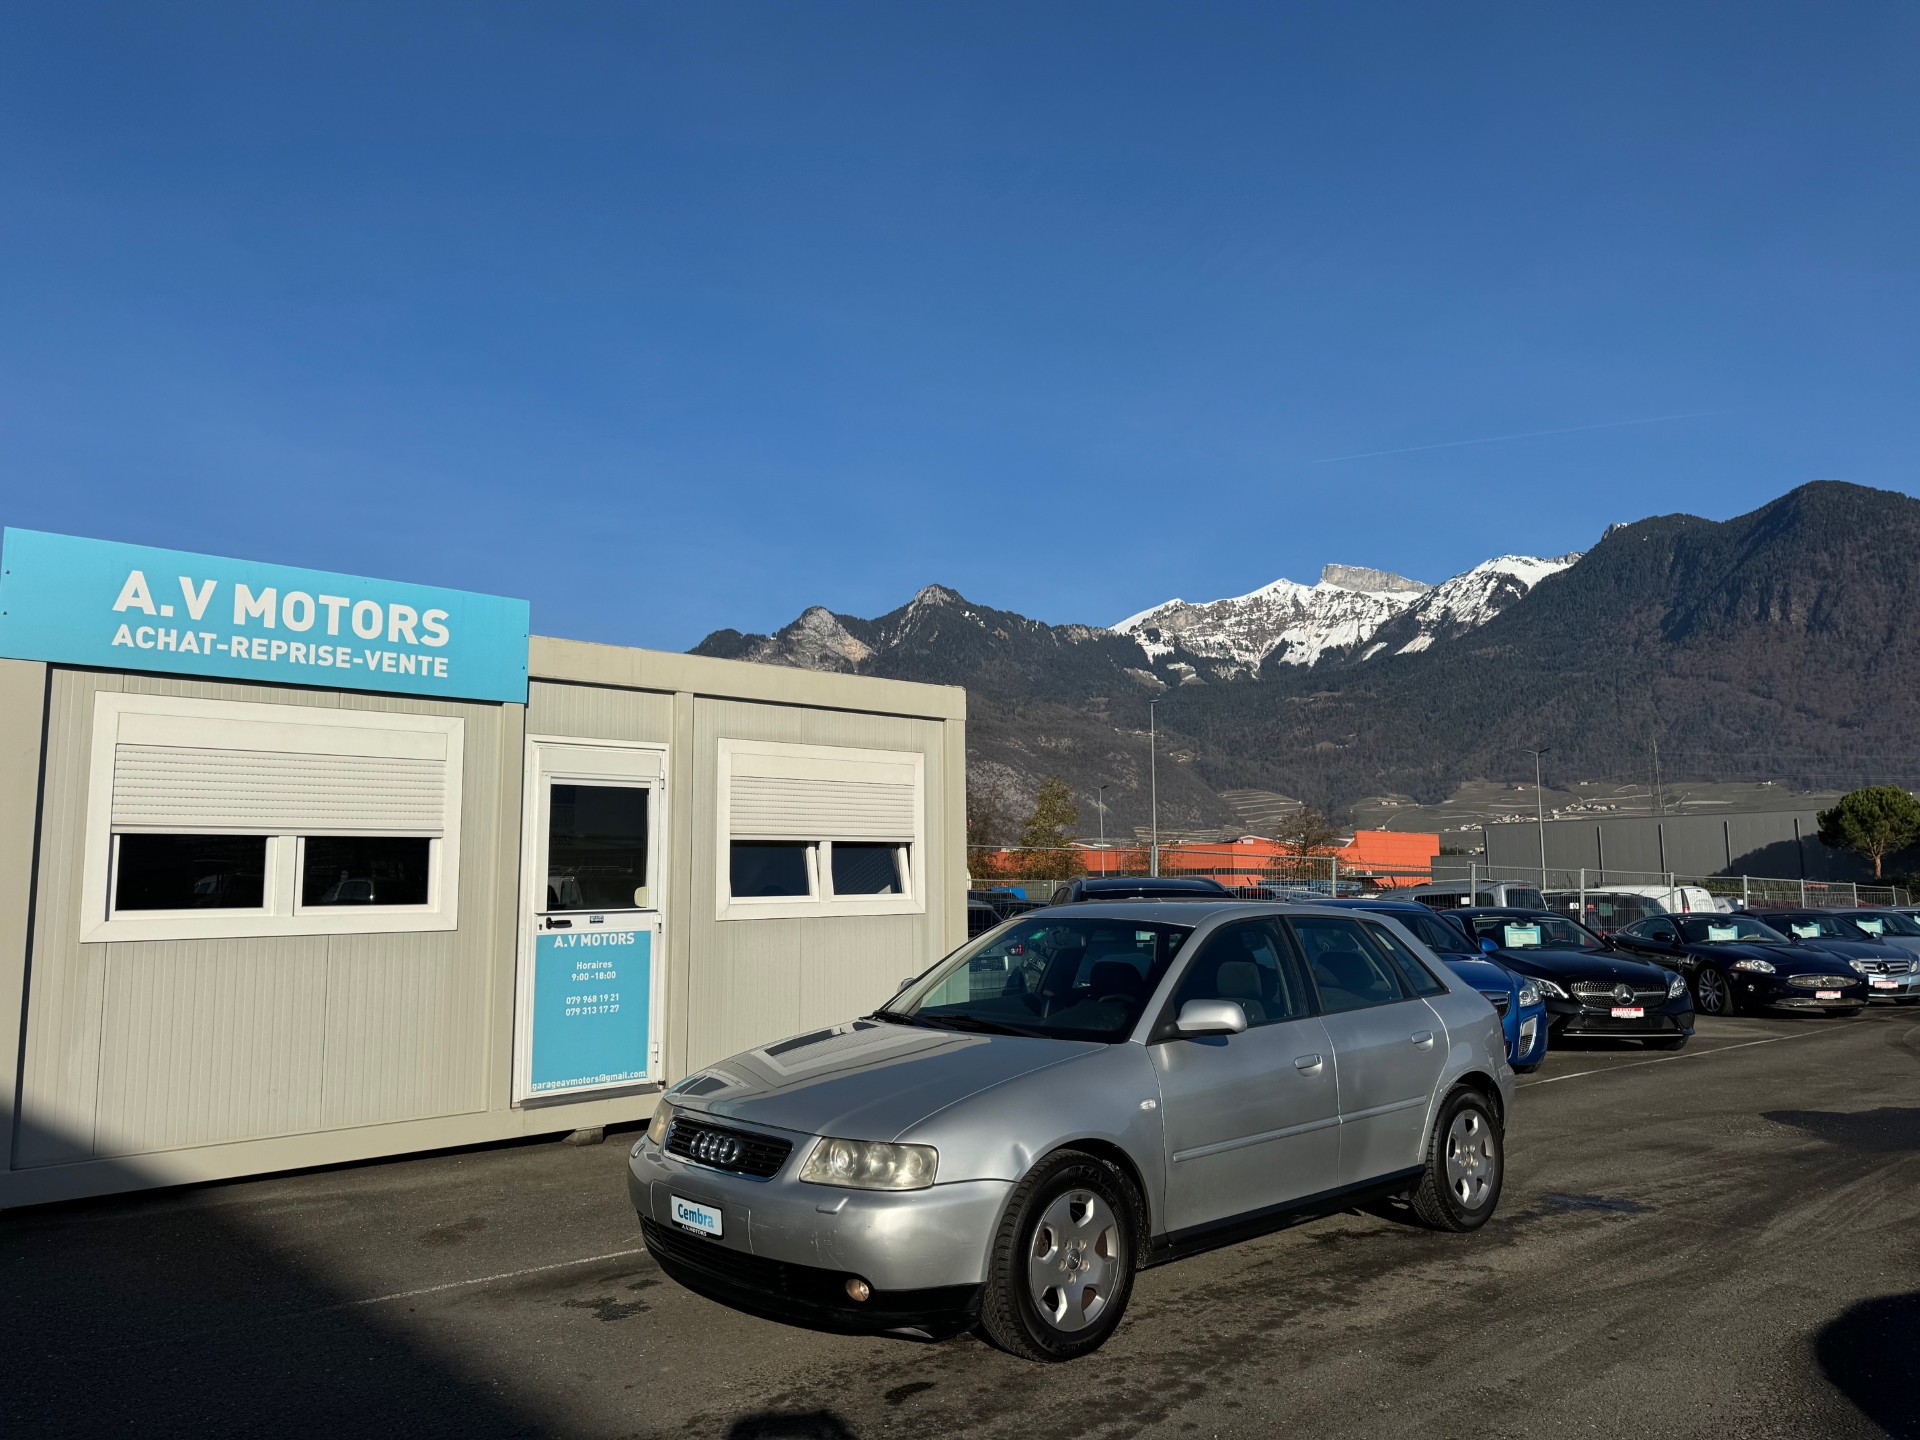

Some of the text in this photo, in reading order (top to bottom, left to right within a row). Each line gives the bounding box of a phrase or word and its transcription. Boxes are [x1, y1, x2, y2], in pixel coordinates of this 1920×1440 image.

[112, 569, 450, 647] A.V MOTORS
[111, 624, 449, 678] ACHAT-REPRISE-VENTE
[553, 932, 635, 948] A.V MOTORS
[576, 960, 613, 970] Horaires
[571, 972, 590, 982] 9:00
[566, 993, 619, 1005] 079 968 19 21
[565, 1004, 619, 1017] 079 313 17 27
[532, 1070, 646, 1091] garageavmotors@gmail.com
[678, 1203, 714, 1228] Cembra
